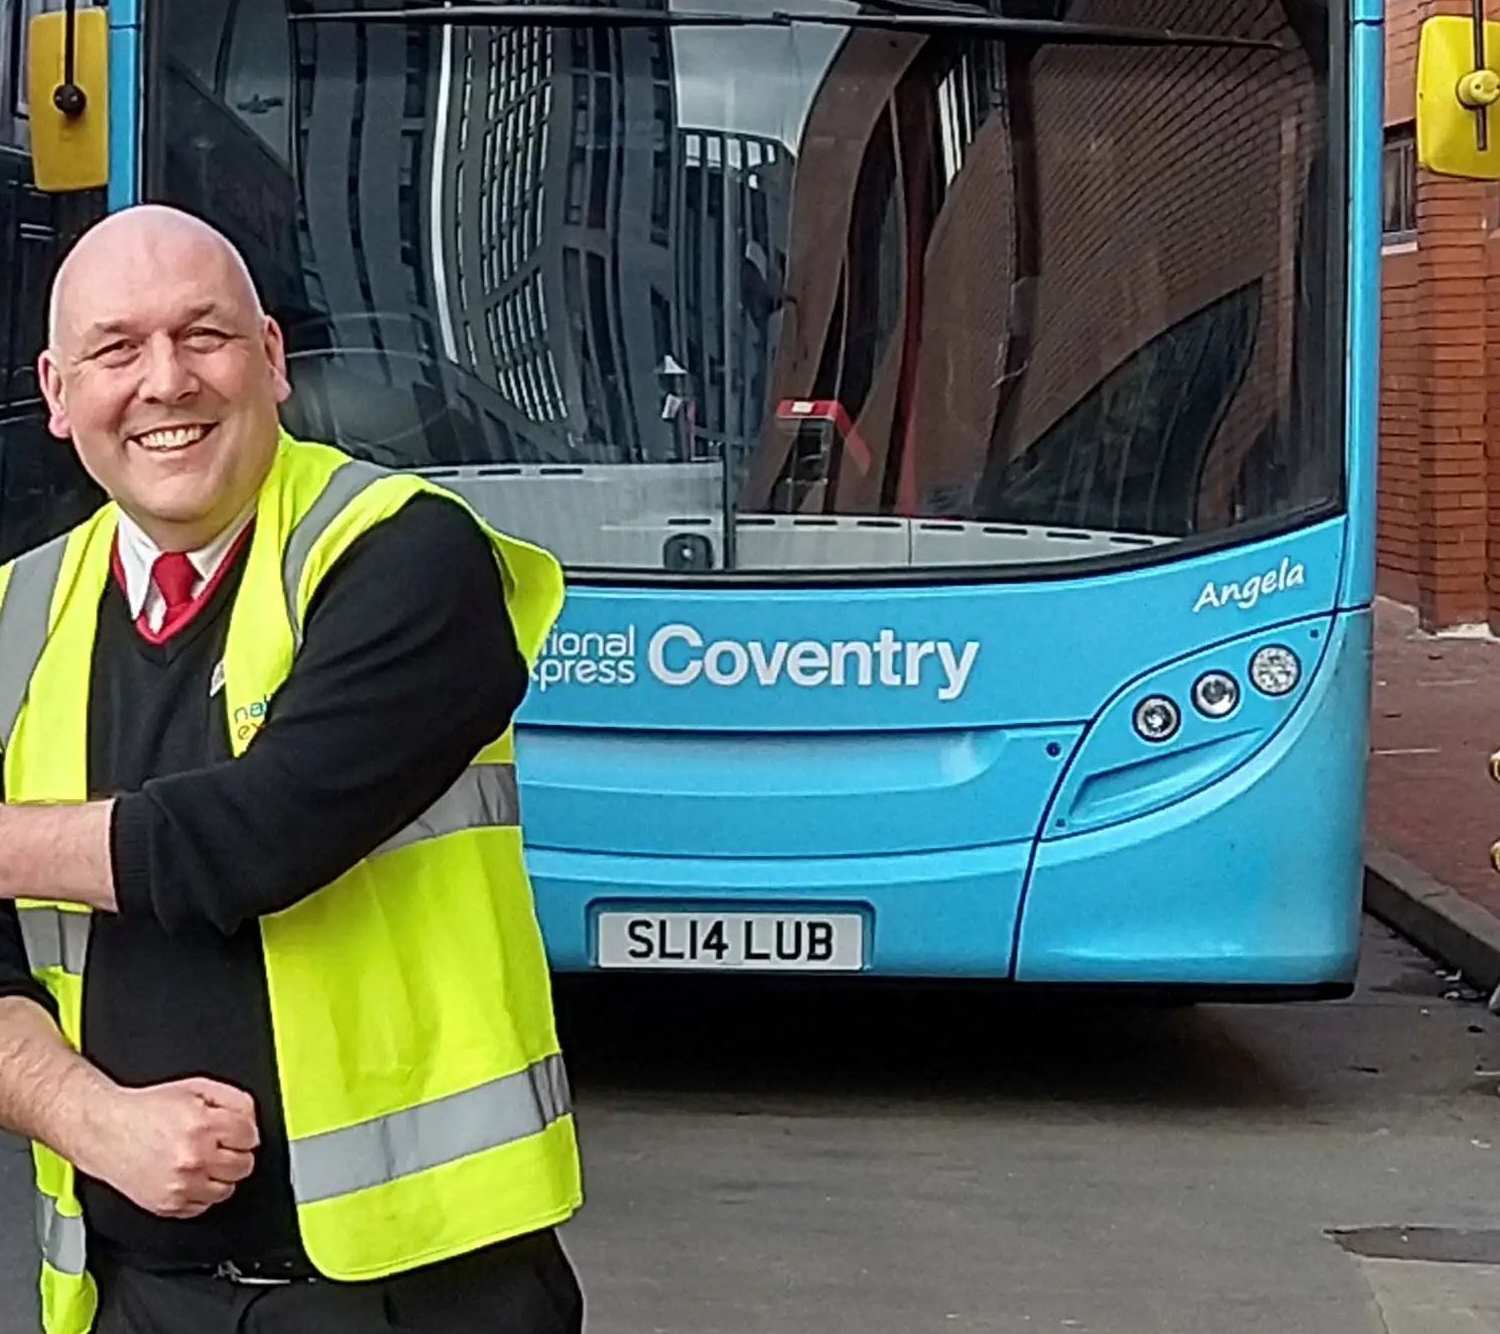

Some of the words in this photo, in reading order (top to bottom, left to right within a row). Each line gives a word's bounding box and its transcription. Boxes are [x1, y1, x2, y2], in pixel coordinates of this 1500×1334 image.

[1192, 557, 1305, 612] Angela
[648, 622, 980, 700] Coventry
[628, 919, 729, 960] SL14
[744, 920, 834, 961] LUB
